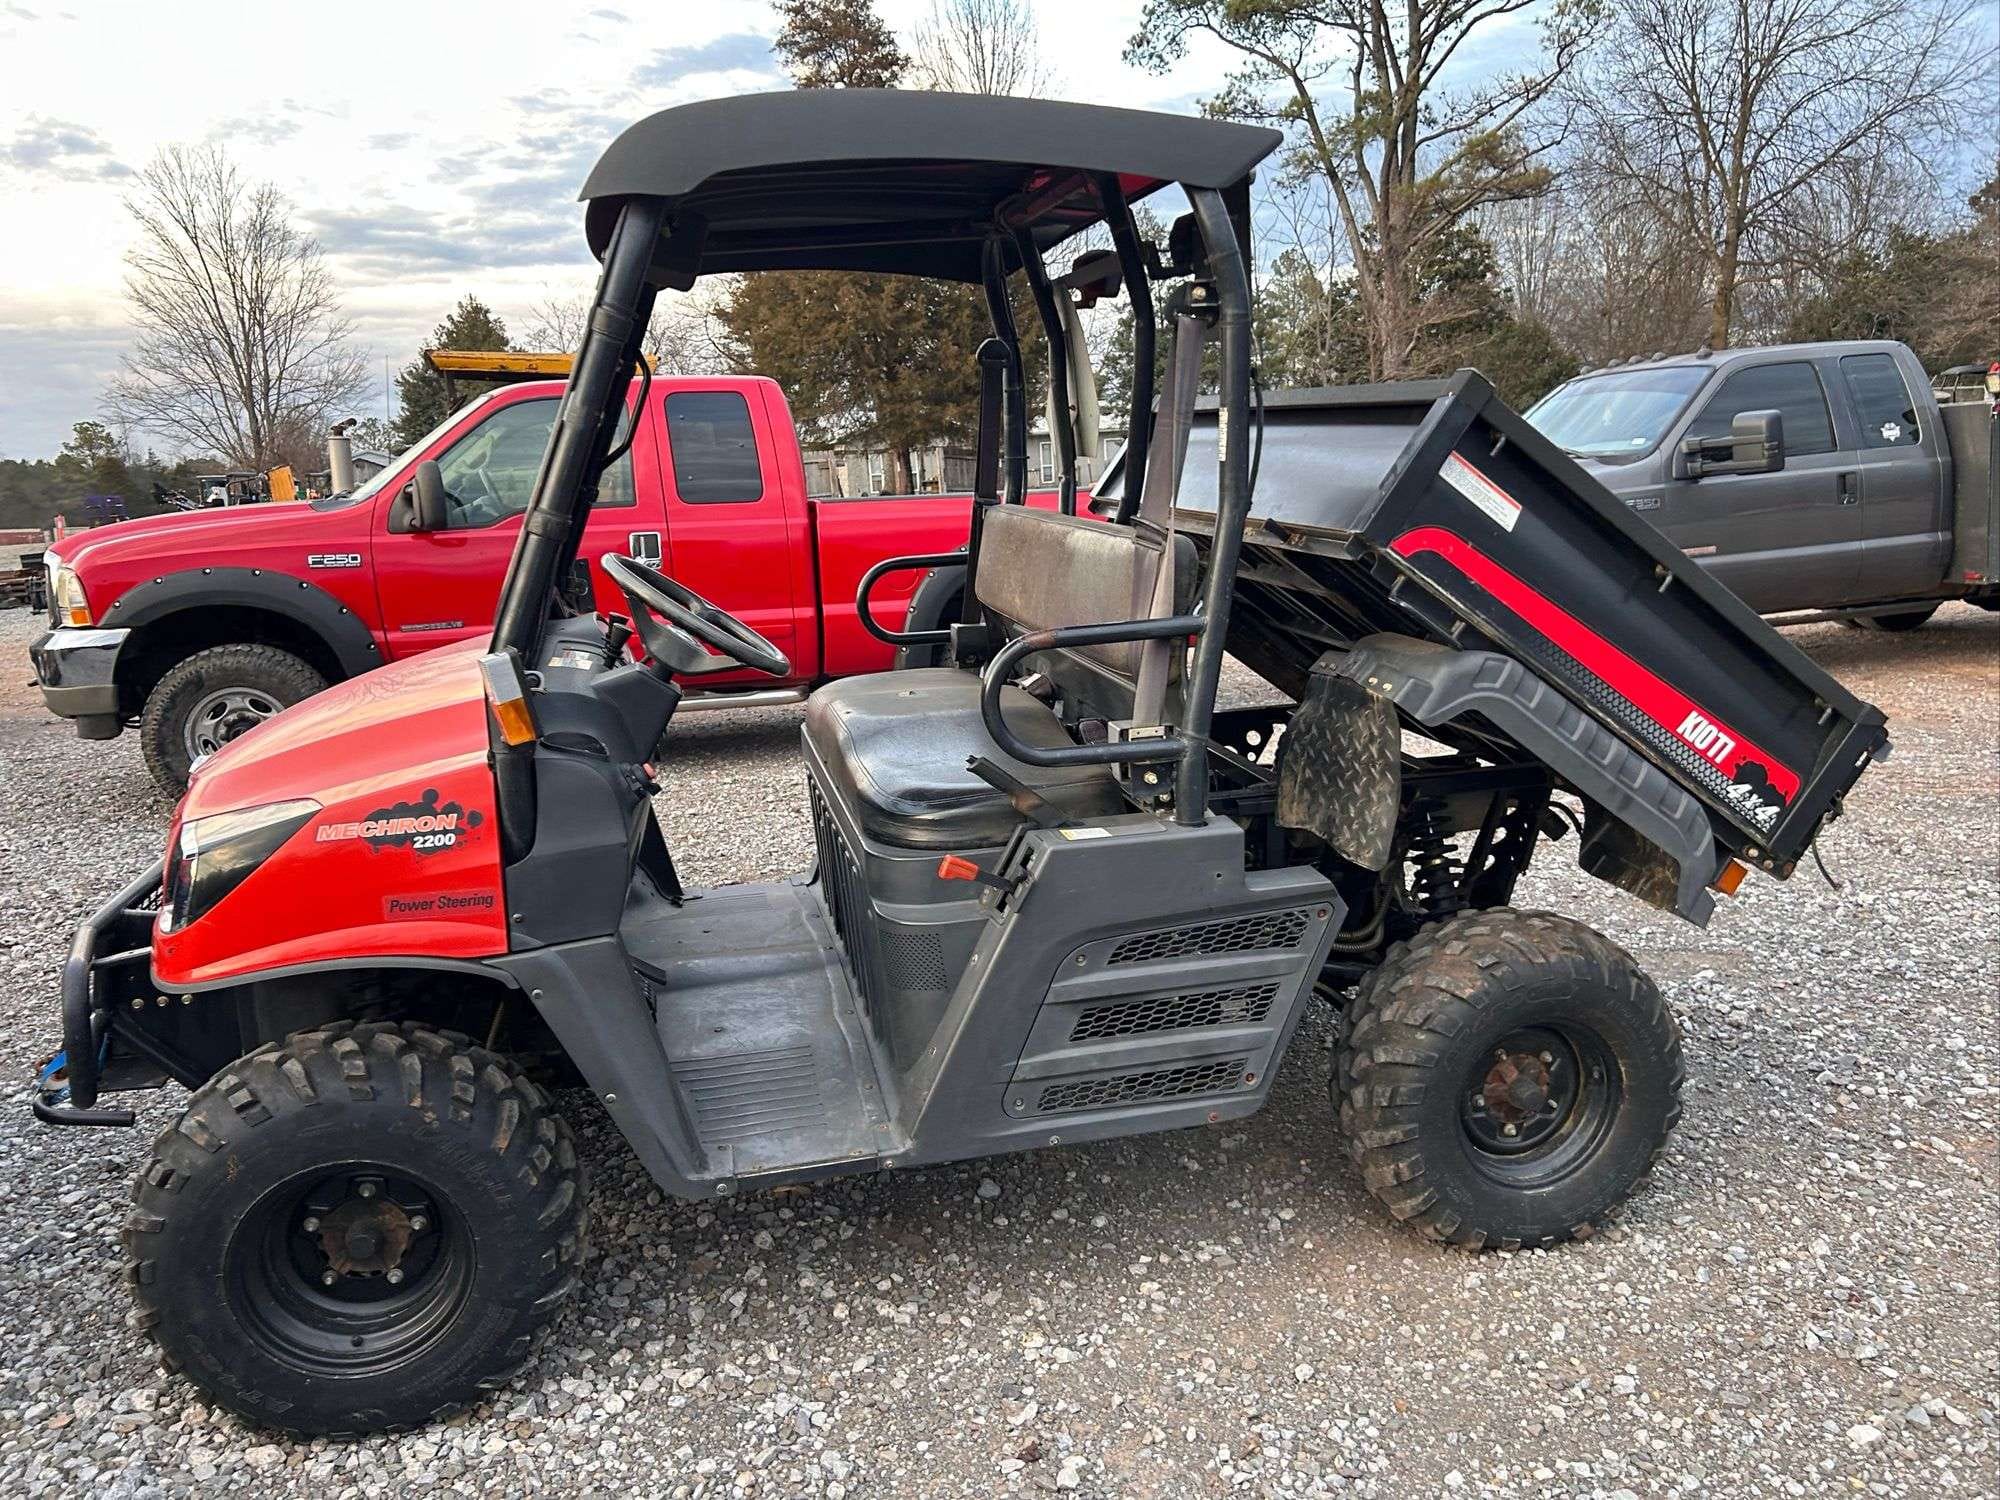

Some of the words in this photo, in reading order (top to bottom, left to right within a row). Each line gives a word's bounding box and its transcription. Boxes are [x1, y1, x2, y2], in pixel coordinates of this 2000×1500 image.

[1676, 710, 1736, 764] KIOTI
[315, 814, 458, 842] MECHRON
[413, 833, 456, 849] 2200
[390, 898, 434, 913] Power
[437, 893, 494, 909] Steering
